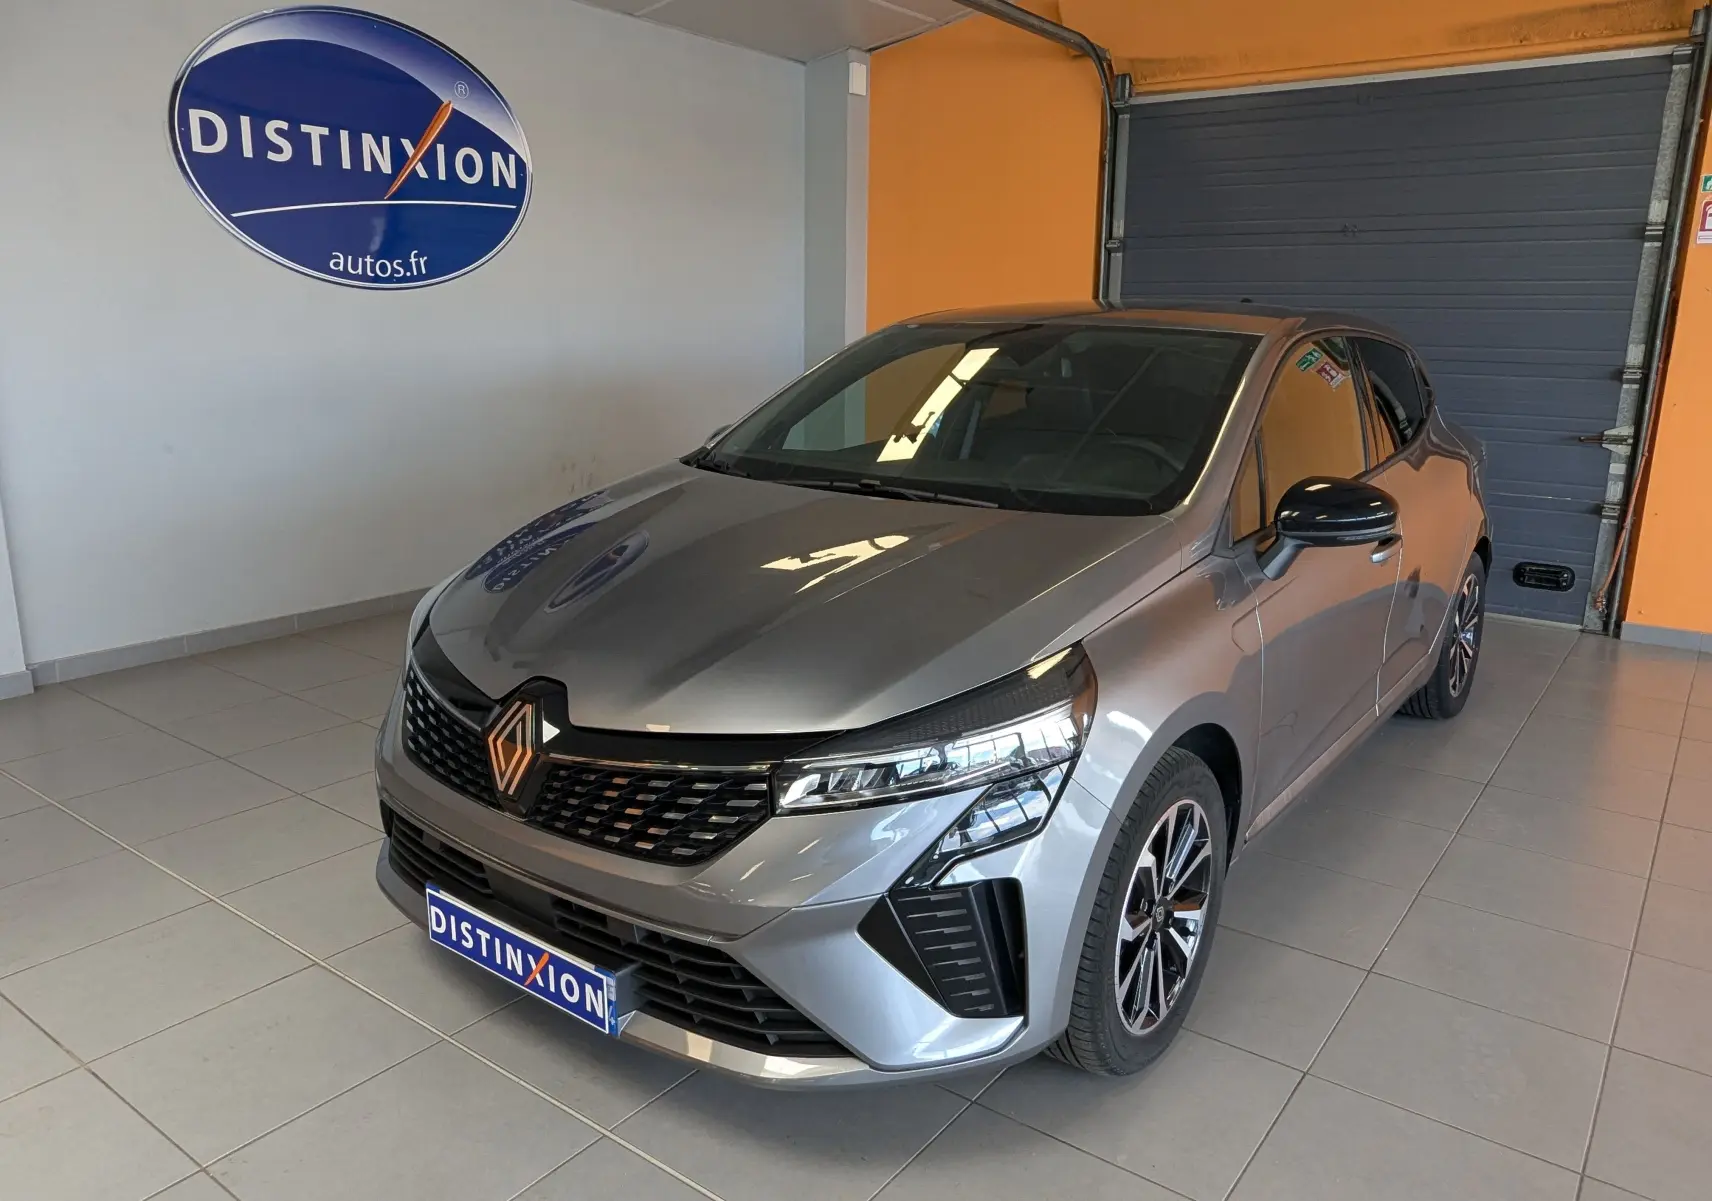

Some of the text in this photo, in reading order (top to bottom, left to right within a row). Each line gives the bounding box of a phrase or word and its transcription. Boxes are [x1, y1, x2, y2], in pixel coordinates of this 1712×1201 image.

[188, 100, 518, 199] DISTINXION
[329, 250, 428, 278] autos.fr
[430, 904, 604, 1019] DISTINXION
